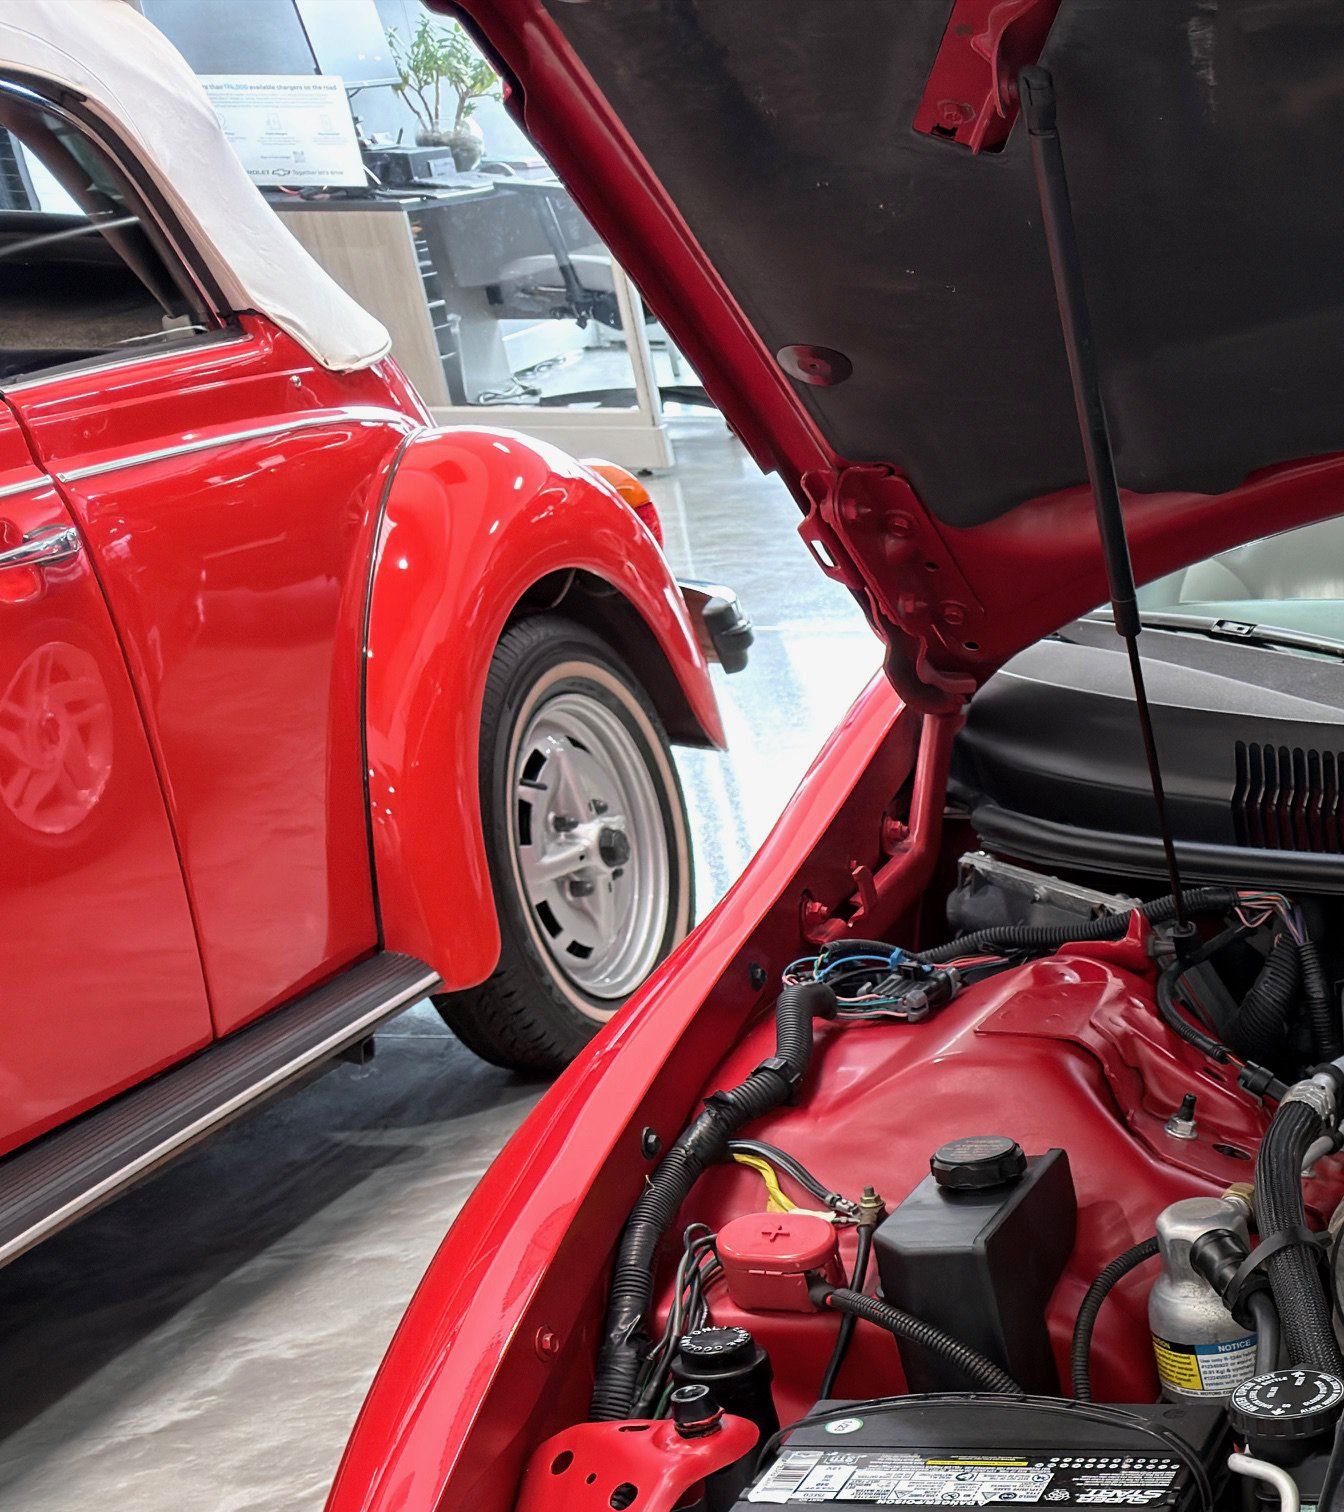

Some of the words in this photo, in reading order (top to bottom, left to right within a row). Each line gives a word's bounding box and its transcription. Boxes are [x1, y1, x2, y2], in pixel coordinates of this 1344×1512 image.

[1218, 1340, 1251, 1352] NOTICE
[1084, 1488, 1166, 1498] START
[1076, 1496, 1149, 1504] SUPER
